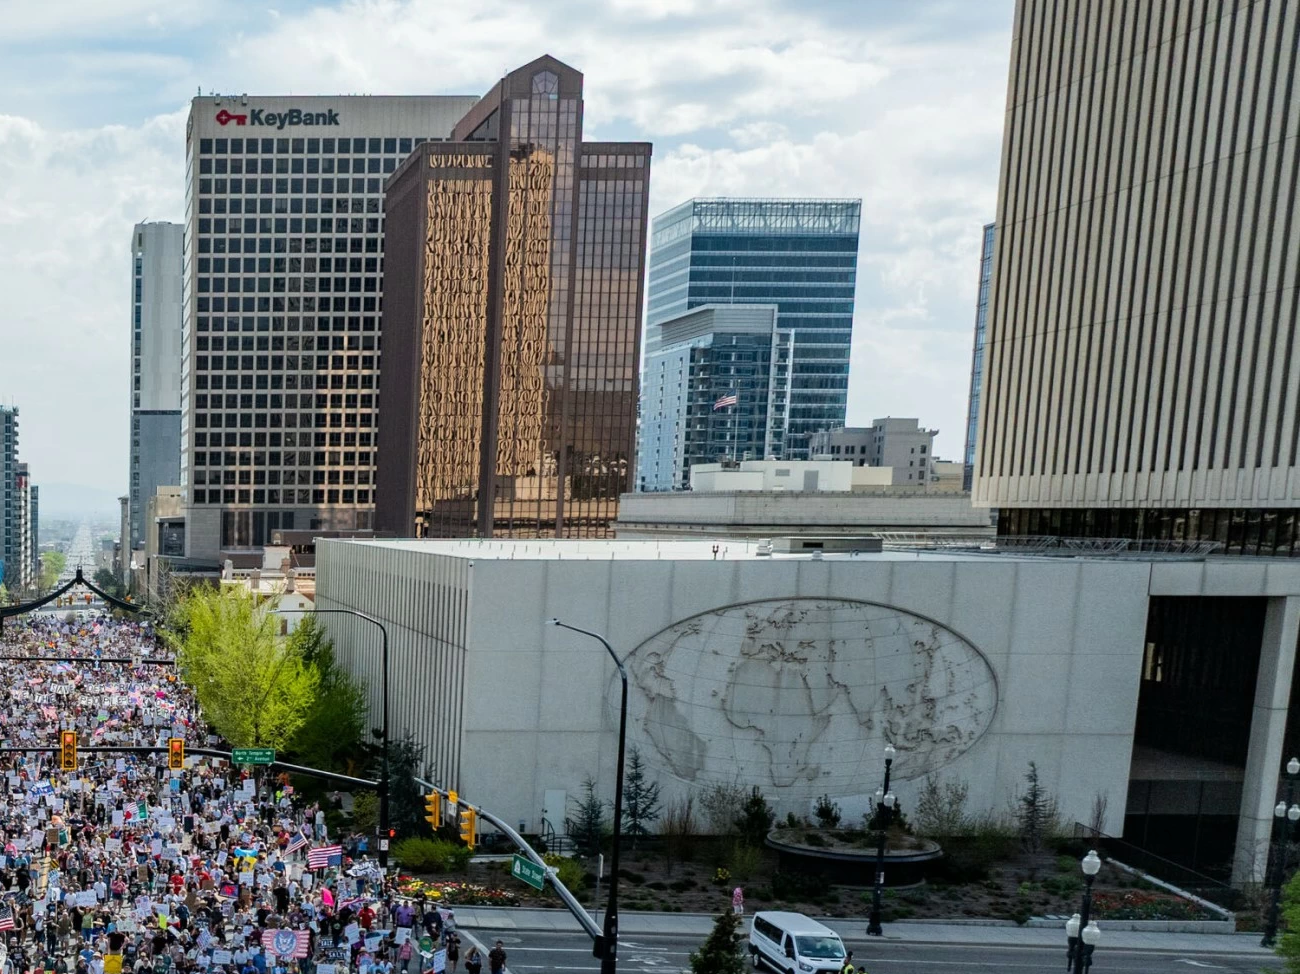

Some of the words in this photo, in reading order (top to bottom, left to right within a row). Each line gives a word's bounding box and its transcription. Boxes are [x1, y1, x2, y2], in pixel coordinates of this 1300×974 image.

[250, 109, 340, 130] KeyBank
[522, 866, 531, 877] State
[531, 870, 542, 883] Street
